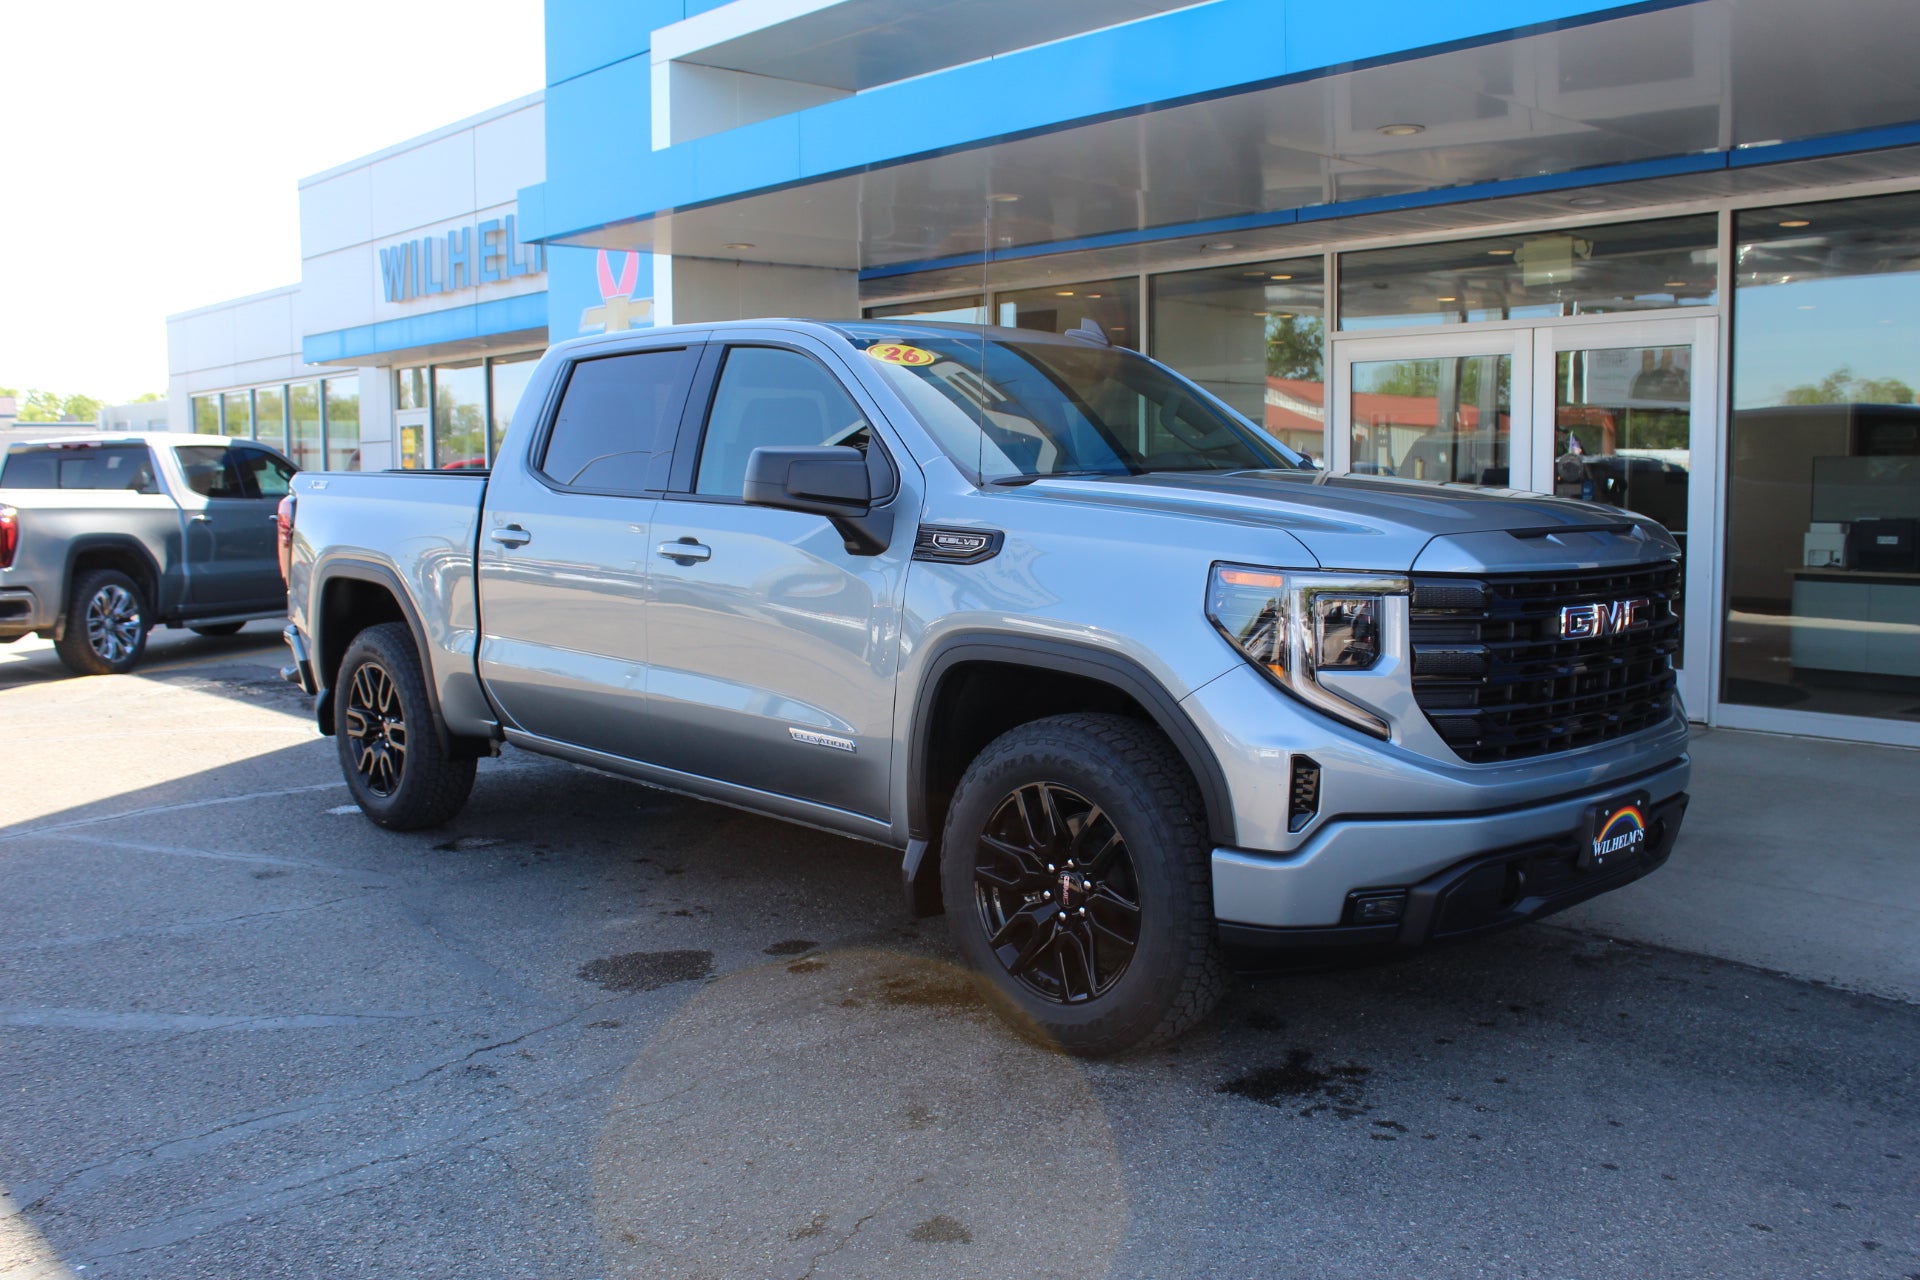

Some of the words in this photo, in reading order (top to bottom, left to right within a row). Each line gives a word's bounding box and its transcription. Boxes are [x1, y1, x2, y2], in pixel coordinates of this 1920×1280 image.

[884, 346, 920, 363] 26
[1560, 599, 1649, 640] GMC
[794, 732, 851, 750] ELEVATION
[1592, 827, 1644, 857] WILHELM'S
